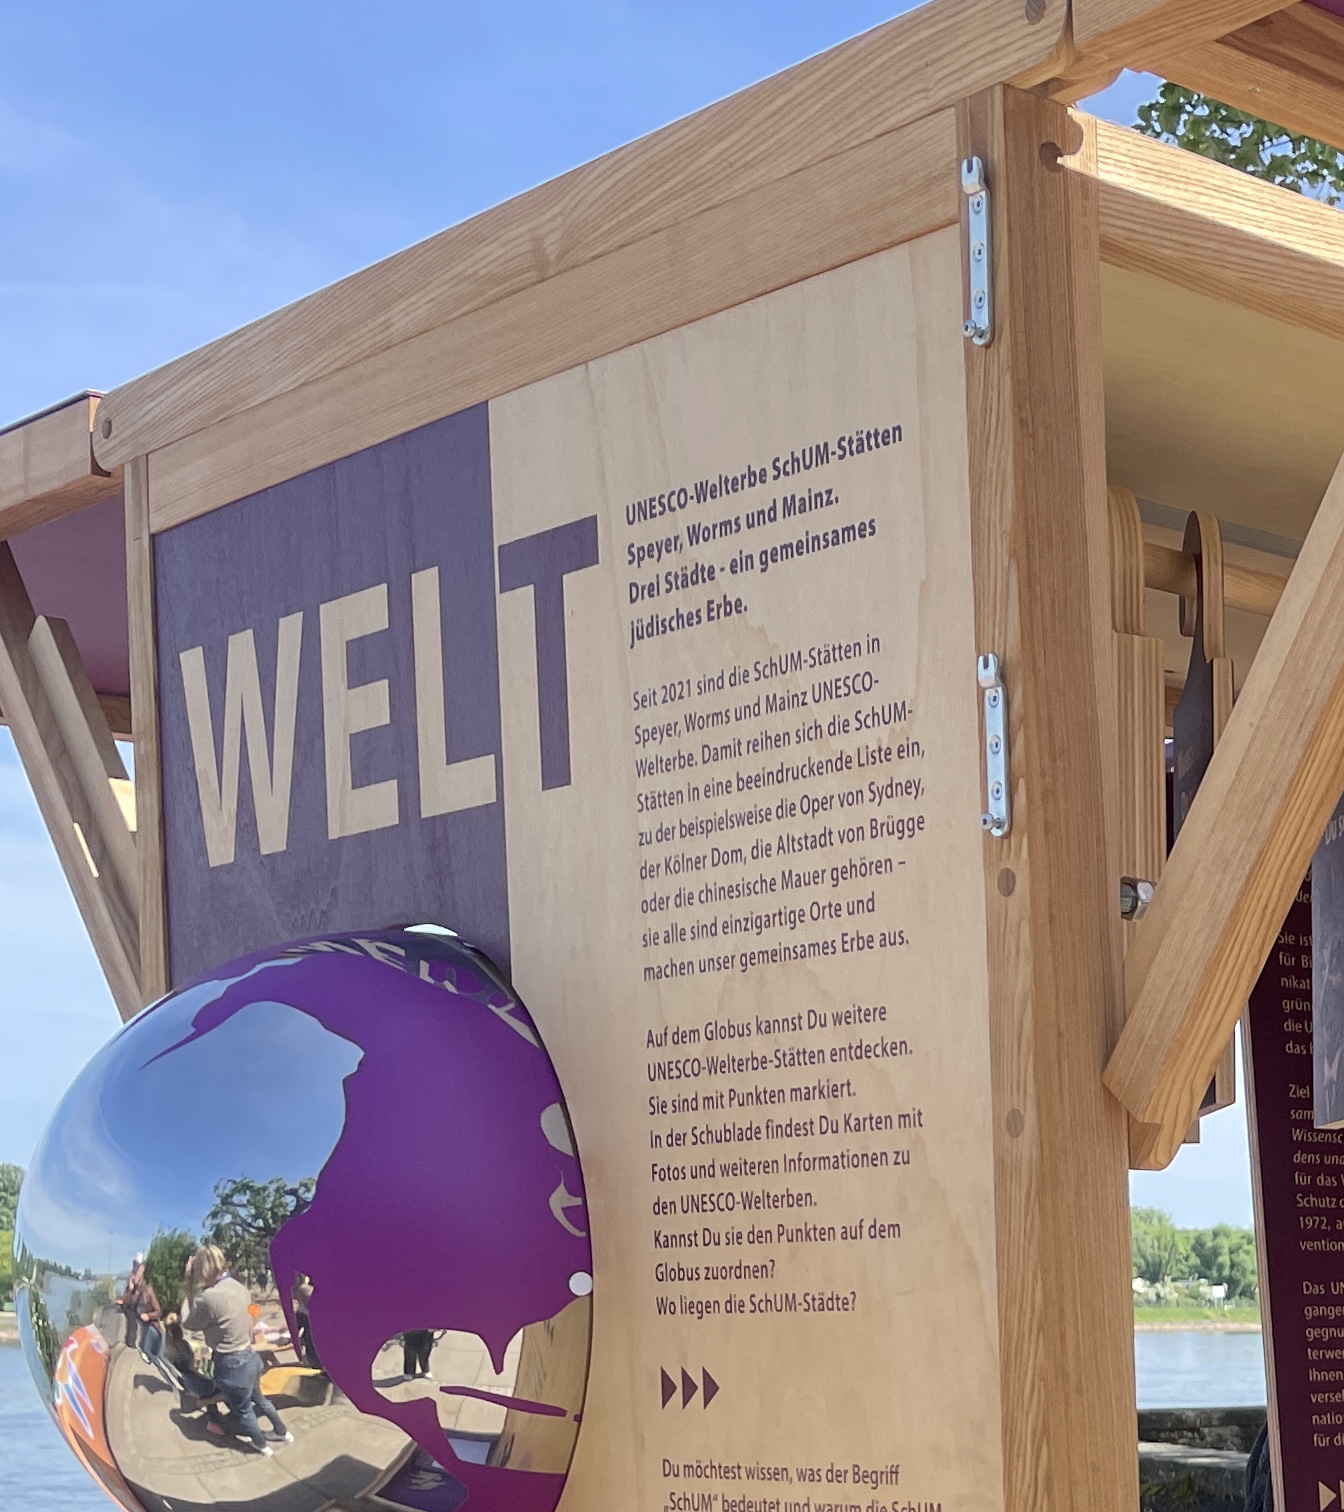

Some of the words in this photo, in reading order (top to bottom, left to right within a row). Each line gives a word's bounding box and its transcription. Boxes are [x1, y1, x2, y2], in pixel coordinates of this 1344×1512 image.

[625, 463, 768, 526] UNESCO-Welterbe
[771, 424, 903, 481] SchUM-Stätten
[626, 533, 684, 569] Speyer,
[686, 515, 742, 547] Worms
[745, 497, 778, 530] und
[782, 487, 839, 520] Mainz.
[628, 573, 661, 605] Drei
[664, 561, 716, 594] Städte
[728, 548, 754, 575] ein
[758, 517, 876, 574] gemeinsames
[629, 606, 702, 650] jüdisches
[706, 593, 748, 622] Erbe.
[179, 514, 599, 868] WELT
[632, 687, 658, 711] Seit
[660, 678, 692, 705] 2021
[696, 668, 725, 696] sind
[728, 664, 750, 688] die
[753, 640, 862, 682] SchUM-Stätten
[866, 632, 881, 655] in
[634, 720, 682, 749] Speyer,
[683, 707, 731, 734] Worms
[734, 694, 761, 722] und
[764, 688, 808, 715] Mainz
[811, 670, 879, 704] UNESCO-
[634, 748, 698, 779] Welterbe.
[700, 737, 743, 765] Damit
[746, 728, 791, 755] reihen
[794, 718, 823, 745] sich
[826, 713, 850, 737] die
[854, 699, 913, 732] SchUM-
[637, 830, 653, 847] zu
[654, 821, 676, 844] der
[678, 803, 772, 839] beispielsweise
[774, 797, 797, 821] die
[799, 793, 835, 820] Oper
[836, 788, 865, 808] von
[867, 775, 925, 807] Sydney,
[645, 1025, 669, 1049] Auf
[670, 1024, 701, 1046] dem
[703, 1017, 752, 1042] Globus
[754, 1012, 803, 1036] kannst
[806, 1008, 827, 1030] Du
[830, 1003, 887, 1027] weitere
[646, 1046, 826, 1083] UNESCO-Welterbe-Stätten
[829, 1035, 913, 1063] entdecken.
[648, 1095, 668, 1116] Sie
[670, 1090, 699, 1114] sind
[702, 1089, 725, 1111] mit
[728, 1084, 786, 1109] Punkten
[789, 1078, 856, 1103] markiert.
[1288, 1083, 1311, 1099] Ziel
[650, 1162, 687, 1183] Fotos
[689, 1157, 716, 1180] und
[718, 1155, 779, 1178] weiteren
[783, 1148, 889, 1174] Informationen
[892, 1149, 910, 1166] zu
[651, 1194, 677, 1216] den
[679, 1187, 817, 1215] UNESCO-Welterben.
[1298, 1215, 1331, 1231] 1972,
[654, 1261, 701, 1283] Globus
[703, 1258, 776, 1281] zuordnen?
[1302, 1280, 1325, 1295] Das
[655, 1295, 677, 1316] Wo
[679, 1294, 721, 1320] liegen
[724, 1292, 746, 1314] die
[748, 1290, 857, 1314] SchUM-Städte?
[661, 1457, 680, 1478] Du
[682, 1458, 742, 1481] möchtest
[744, 1460, 793, 1485] wissen,
[795, 1467, 822, 1483] was
[824, 1462, 849, 1484] der
[851, 1463, 900, 1491] Begriff
